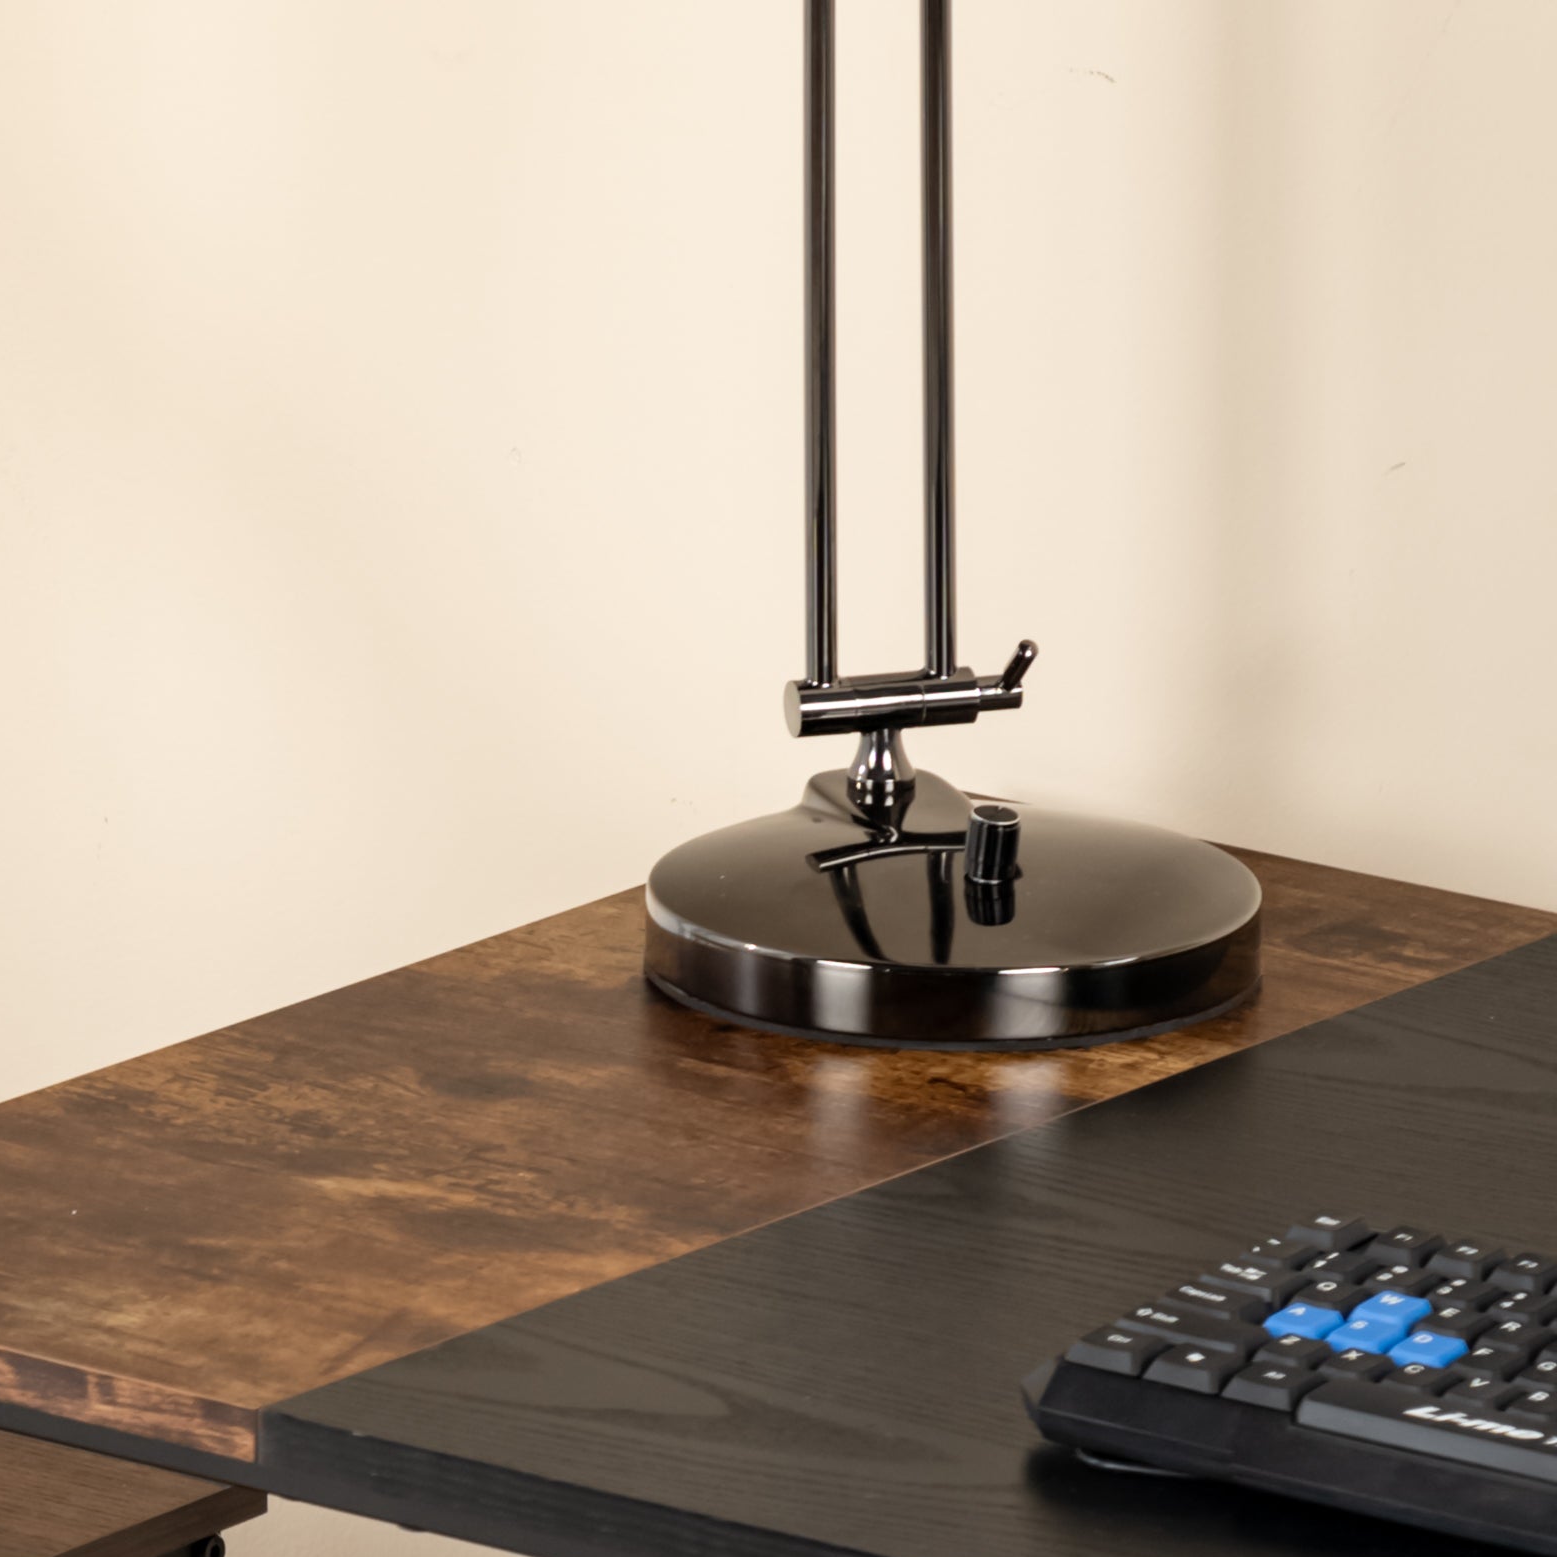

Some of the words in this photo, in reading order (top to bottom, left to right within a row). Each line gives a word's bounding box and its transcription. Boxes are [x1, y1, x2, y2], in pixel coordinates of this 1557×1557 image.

[1379, 1293, 1405, 1306] W
[1288, 1306, 1307, 1316] A
[1438, 1307, 1461, 1318] E
[1499, 1321, 1523, 1332] R
[1412, 1333, 1434, 1344] D
[1341, 1349, 1364, 1361] X
[1472, 1347, 1494, 1356] F
[1469, 1377, 1491, 1388] V
[1527, 1391, 1551, 1401] B
